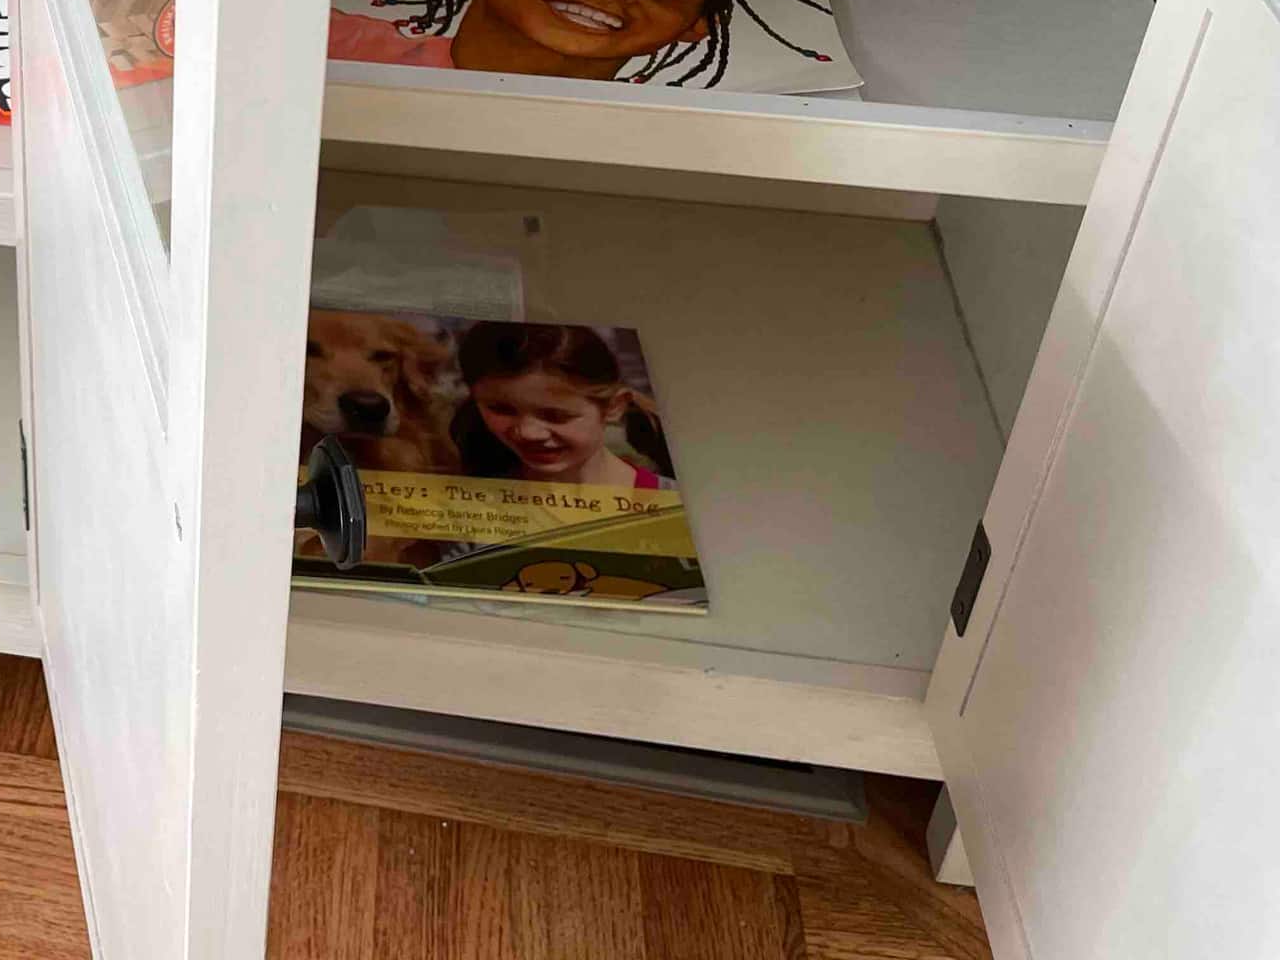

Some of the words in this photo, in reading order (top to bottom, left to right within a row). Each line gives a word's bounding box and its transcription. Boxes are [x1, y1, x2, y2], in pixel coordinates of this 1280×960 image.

[446, 486, 487, 502] The
[502, 488, 602, 513] Reading
[615, 496, 660, 515] Dog
[379, 503, 393, 516] By
[396, 505, 446, 518] Rebecca
[486, 511, 529, 525] Bridges
